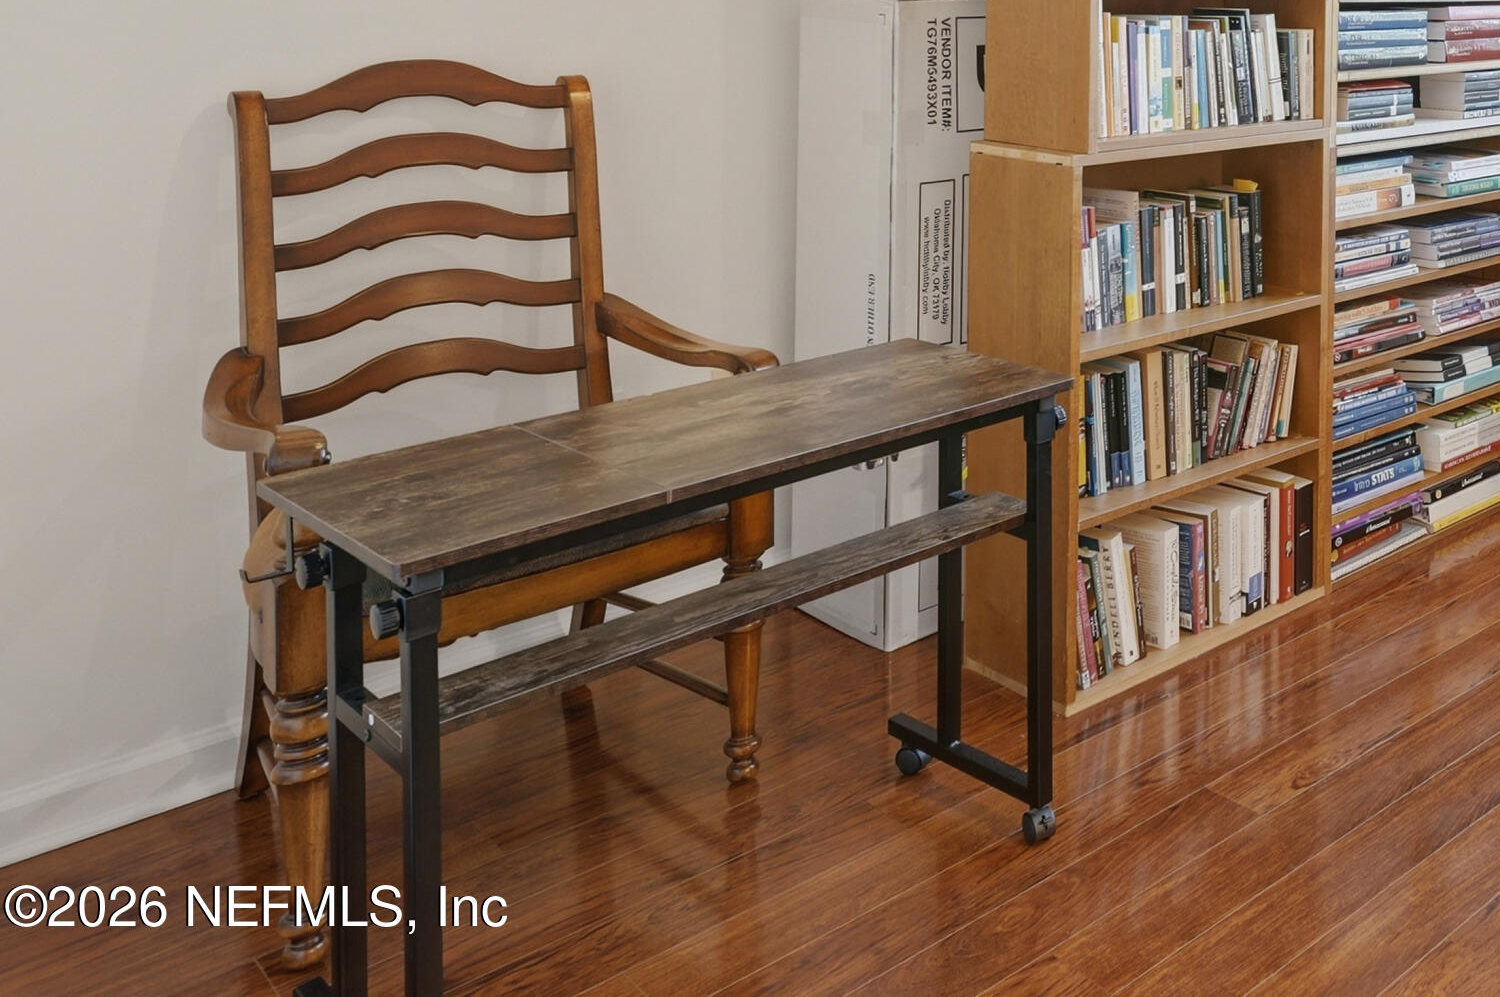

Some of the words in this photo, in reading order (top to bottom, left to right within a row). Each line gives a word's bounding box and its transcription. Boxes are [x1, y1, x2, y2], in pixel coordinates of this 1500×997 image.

[941, 17, 951, 80] VENDOR
[941, 85, 952, 132] ITEM#:
[932, 277, 940, 293] OK
